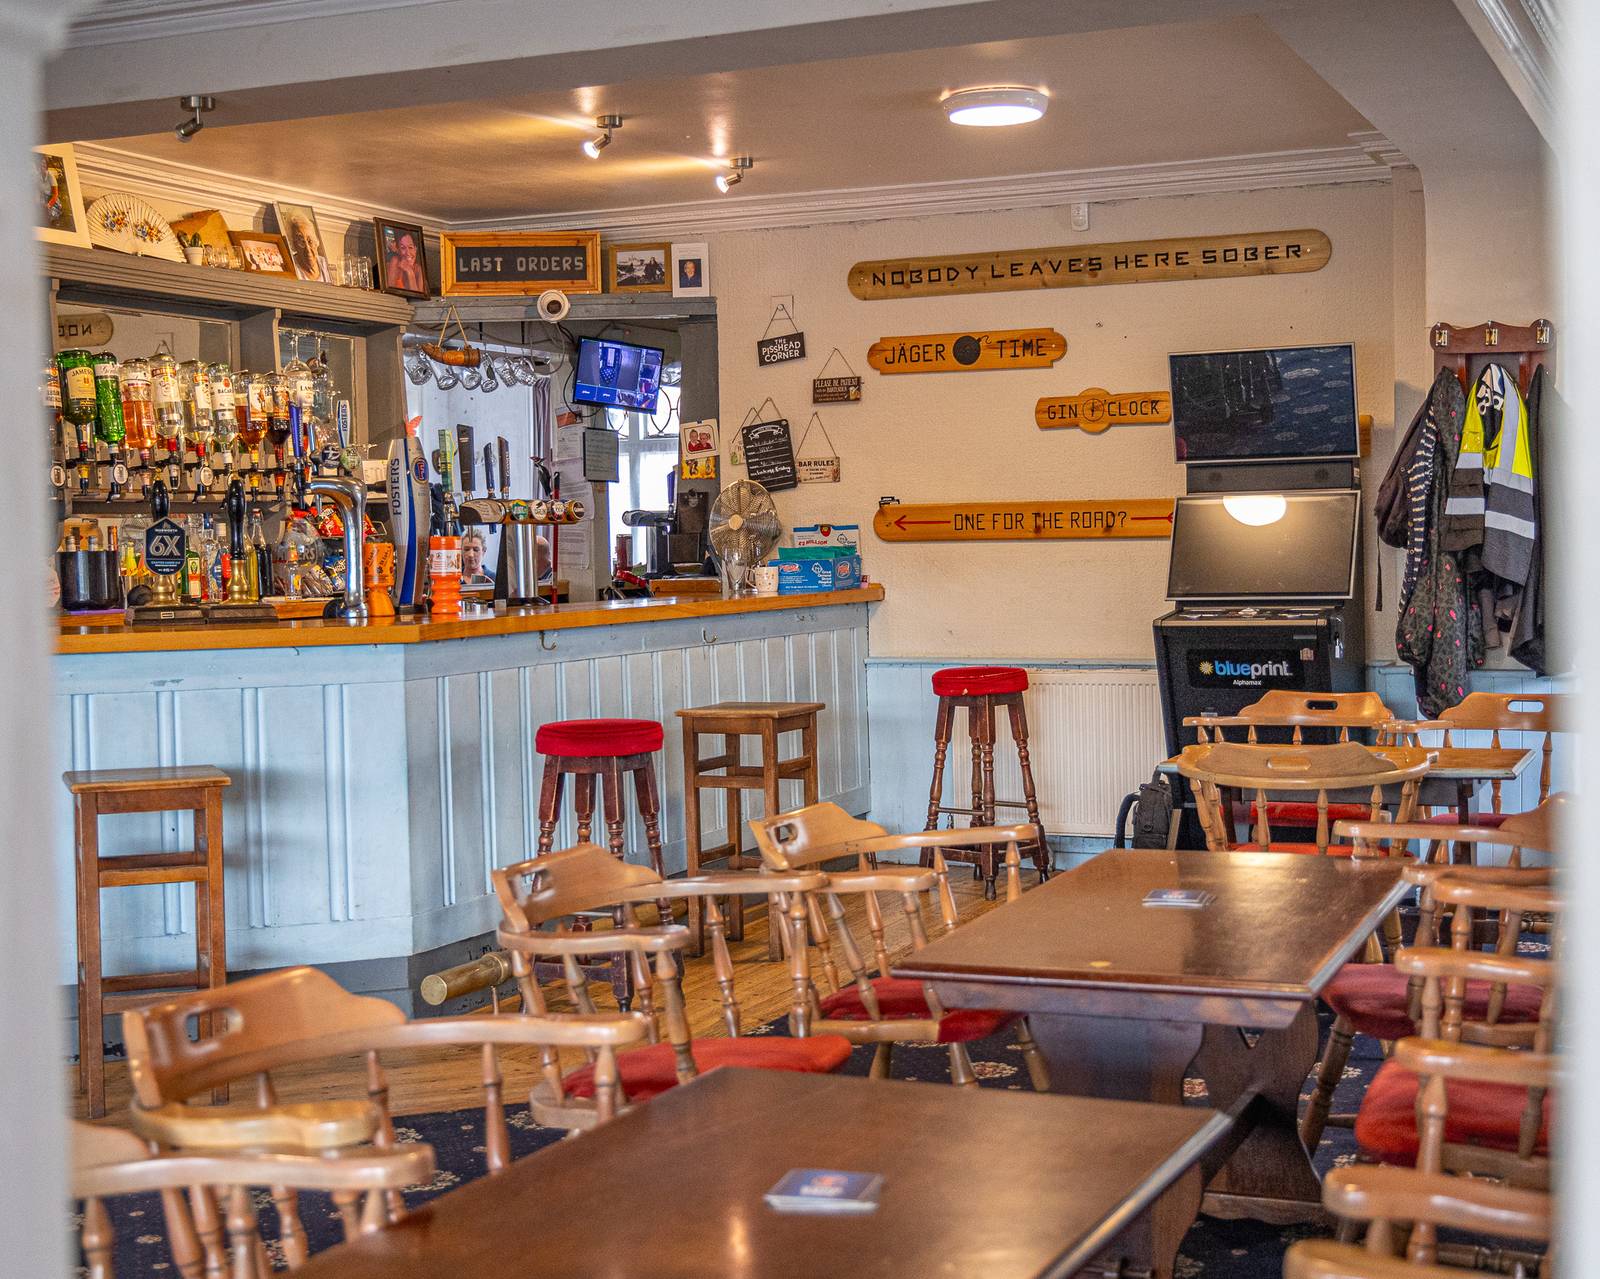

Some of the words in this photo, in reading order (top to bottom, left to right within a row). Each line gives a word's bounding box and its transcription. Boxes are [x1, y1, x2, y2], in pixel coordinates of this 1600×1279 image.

[459, 256, 503, 273] LAST
[516, 256, 585, 272] ORDERS
[872, 265, 979, 287] NOBODY
[991, 256, 1102, 279] LEAVES
[1114, 251, 1190, 271] HERE
[1202, 244, 1302, 265] SOBER
[762, 341, 801, 356] PISSHEAD
[764, 350, 800, 362] CORNER
[884, 343, 946, 365] JÄGER
[997, 338, 1047, 359] TIME
[1047, 403, 1078, 420] GIN
[798, 460, 812, 468] BAR
[813, 460, 835, 468] RULES
[391, 458, 402, 516] FOSTERS
[953, 513, 985, 531] ONE
[992, 513, 1025, 531] FOR
[1032, 511, 1064, 529] THE
[1070, 510, 1127, 529] ROAD?
[150, 535, 181, 556] 6X
[1215, 660, 1289, 680] blueprint
